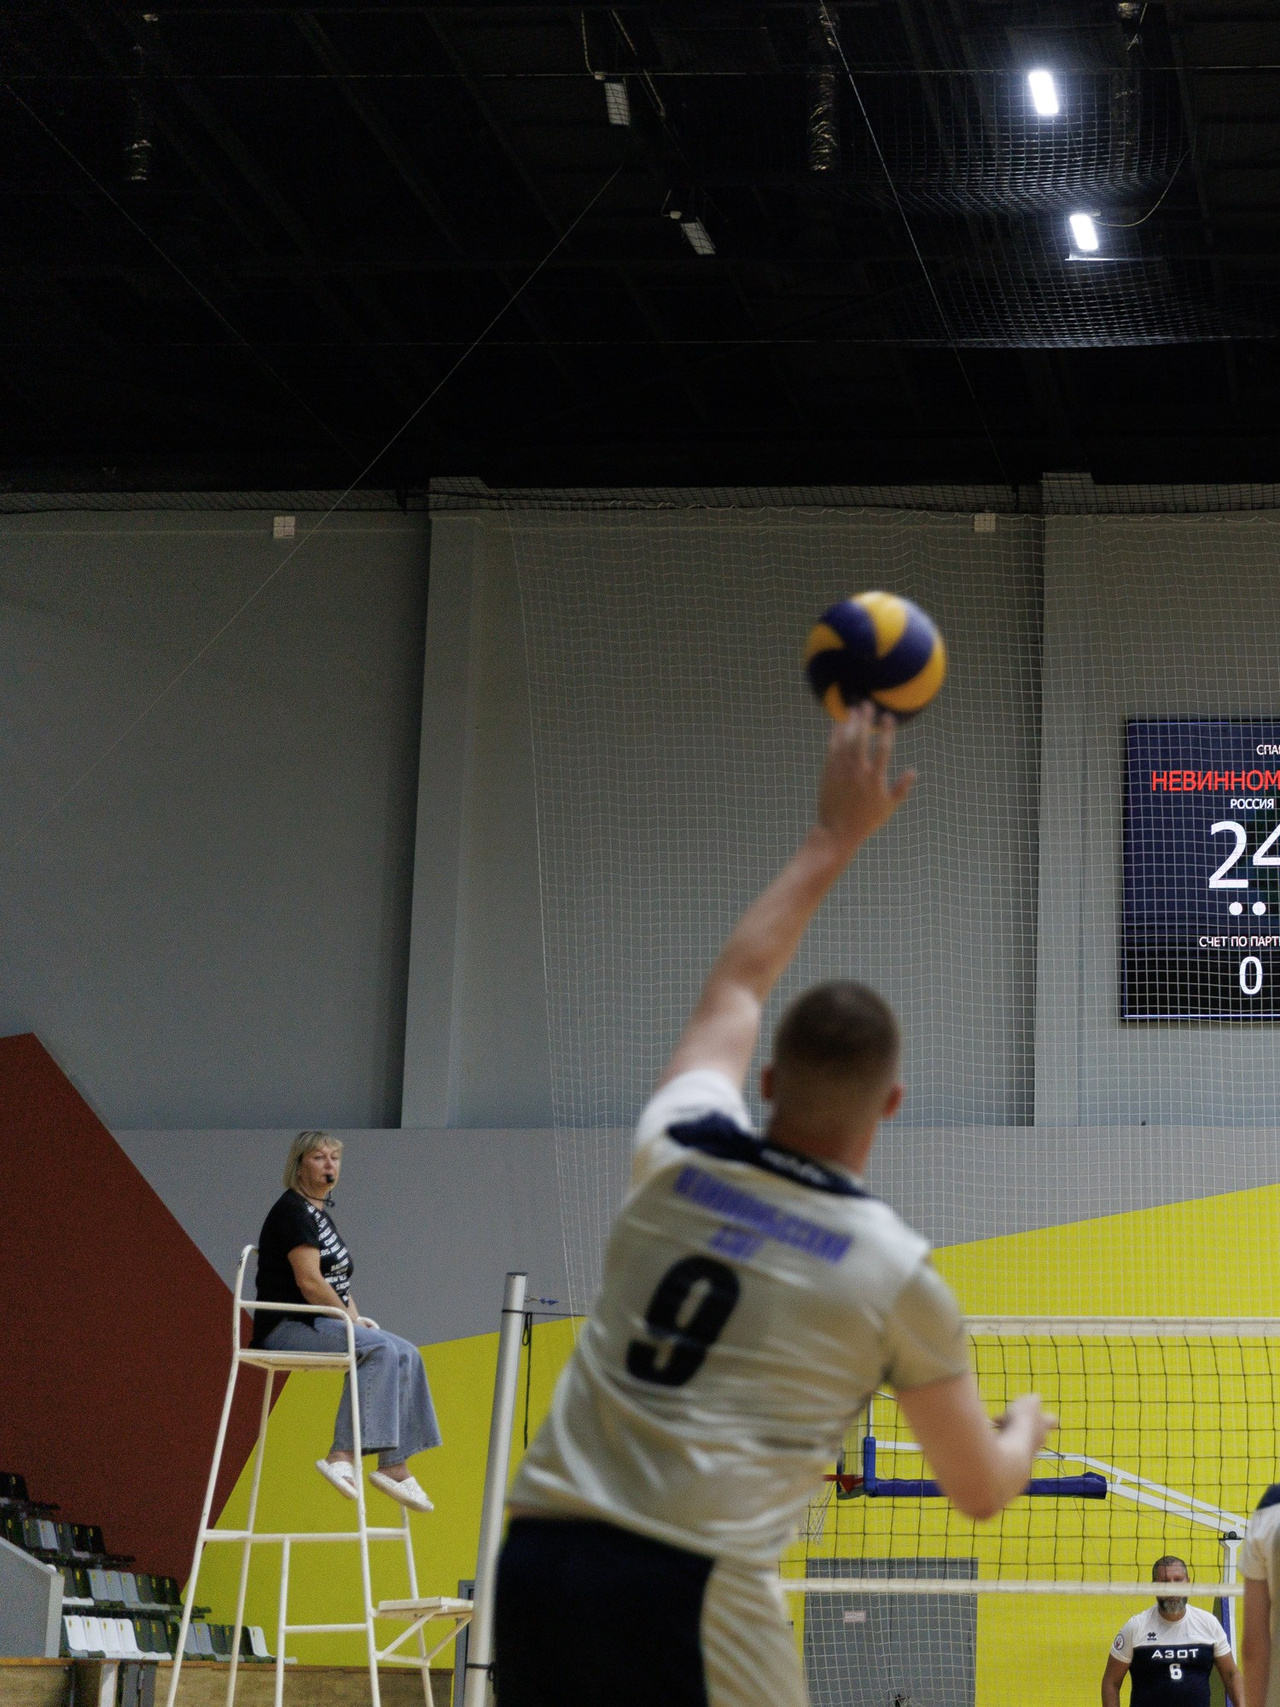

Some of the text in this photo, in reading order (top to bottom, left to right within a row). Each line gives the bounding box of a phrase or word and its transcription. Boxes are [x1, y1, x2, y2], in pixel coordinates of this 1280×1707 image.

[1230, 798, 1274, 809] РОССИЯ
[1199, 936, 1228, 947] СЧЕТ
[1230, 936, 1247, 947] ПО
[1239, 956, 1263, 995] 0
[626, 1255, 740, 1388] 9
[1152, 1648, 1199, 1659] АЗОТ
[1169, 1663, 1183, 1680] 6
